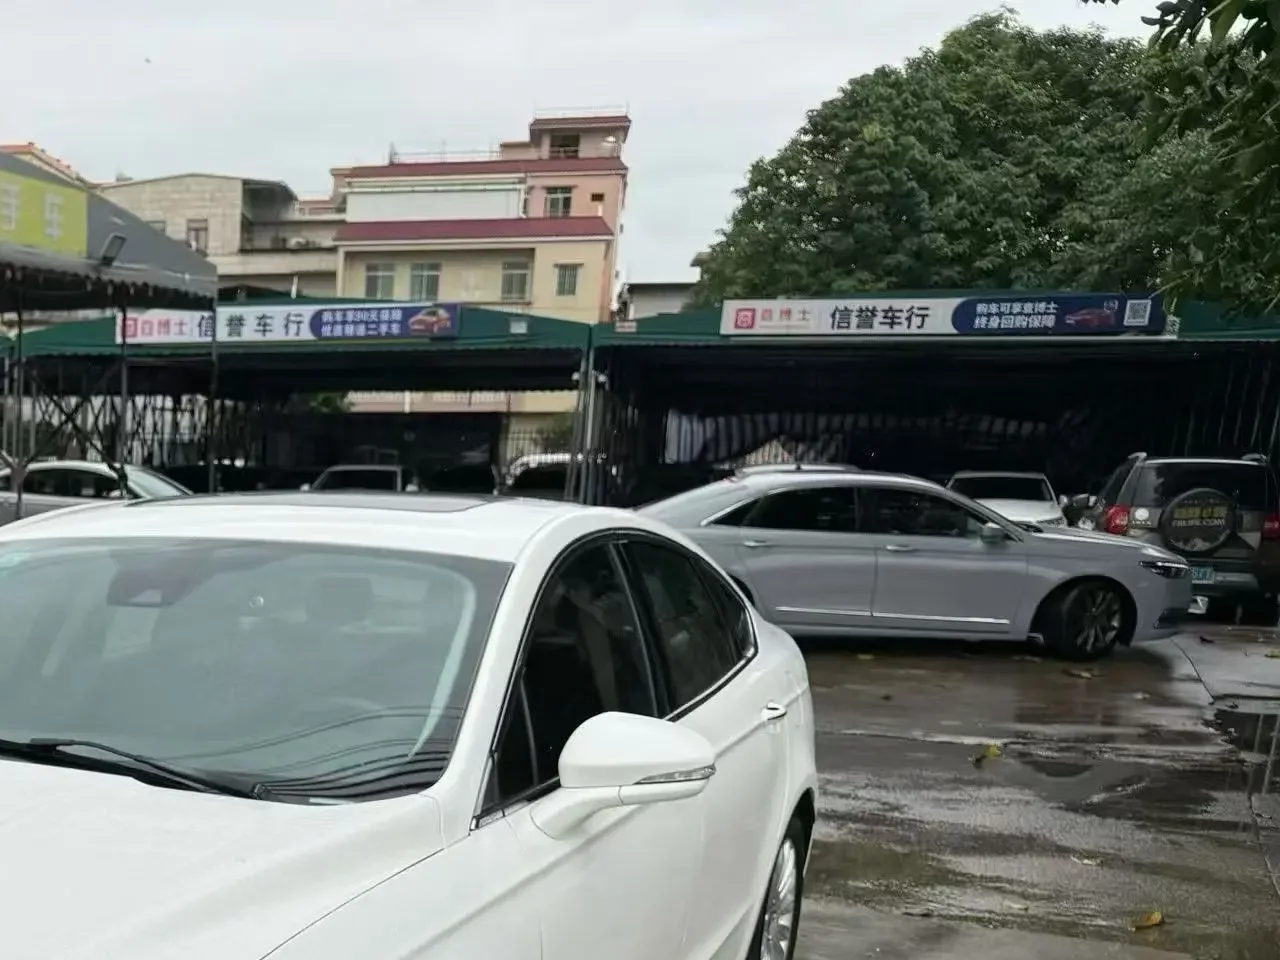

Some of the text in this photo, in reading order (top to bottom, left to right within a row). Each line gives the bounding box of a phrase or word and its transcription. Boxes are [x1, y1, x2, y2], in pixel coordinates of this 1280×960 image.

[197, 313, 305, 338] 信誉车行
[829, 305, 930, 330] 信誉车行
